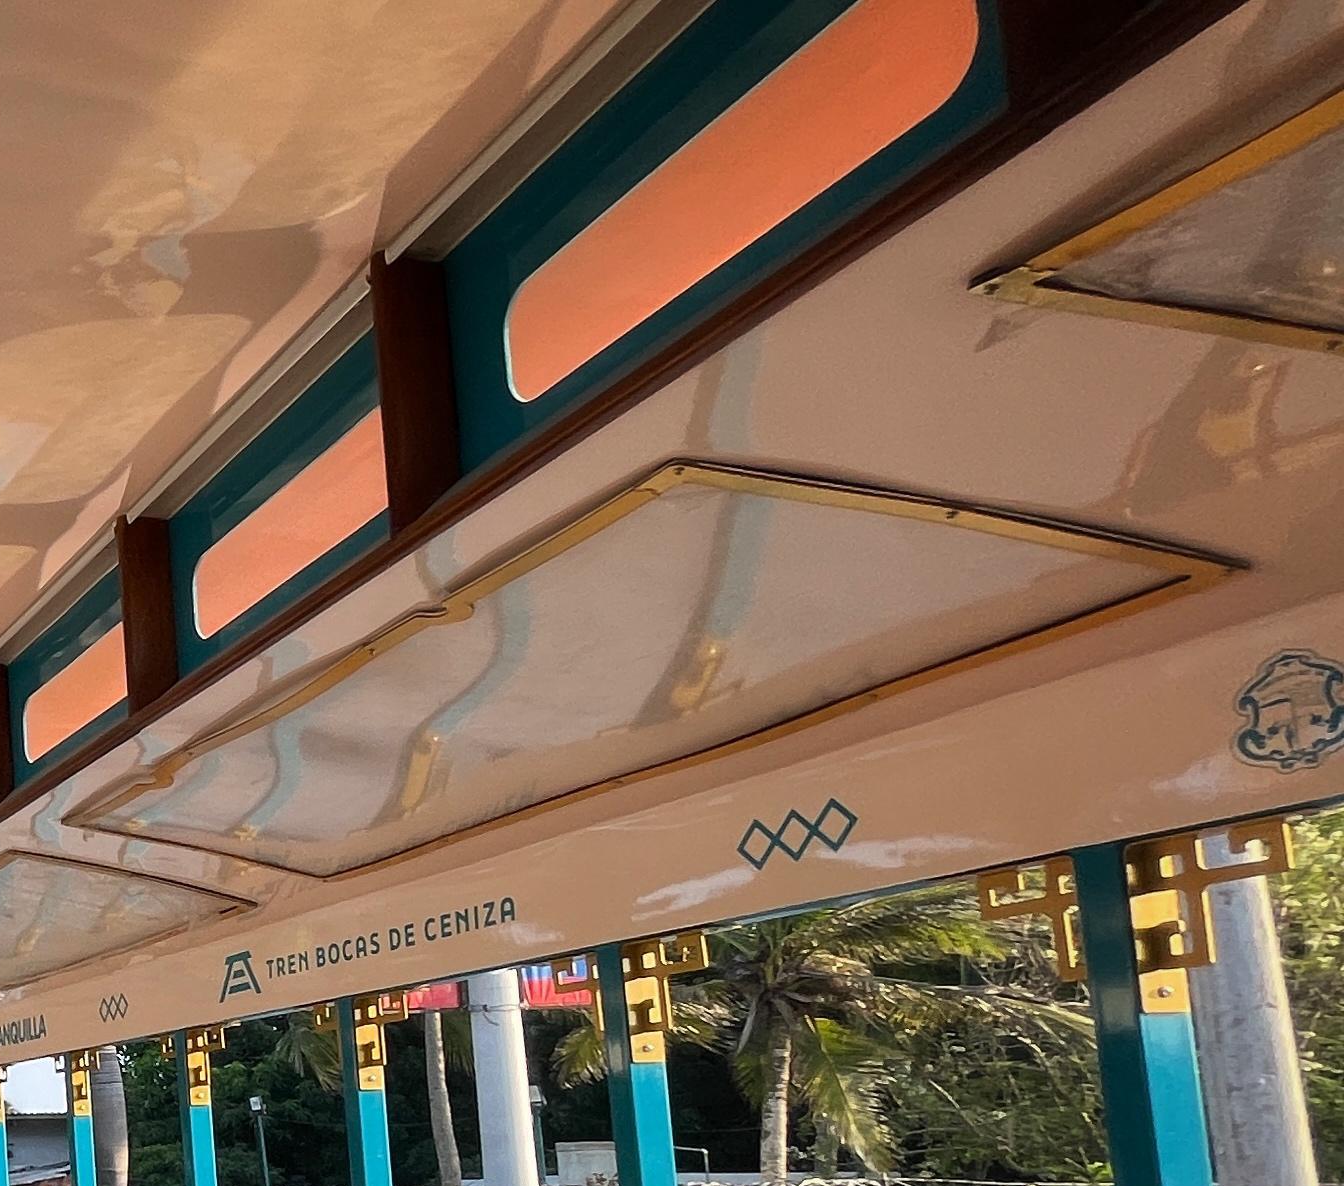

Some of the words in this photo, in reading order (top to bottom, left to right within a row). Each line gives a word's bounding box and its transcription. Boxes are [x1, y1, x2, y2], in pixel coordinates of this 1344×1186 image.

[266, 951, 310, 979] TREN
[316, 932, 380, 968] BOCAS
[389, 923, 416, 951] DE
[424, 896, 516, 942] CENIZA
